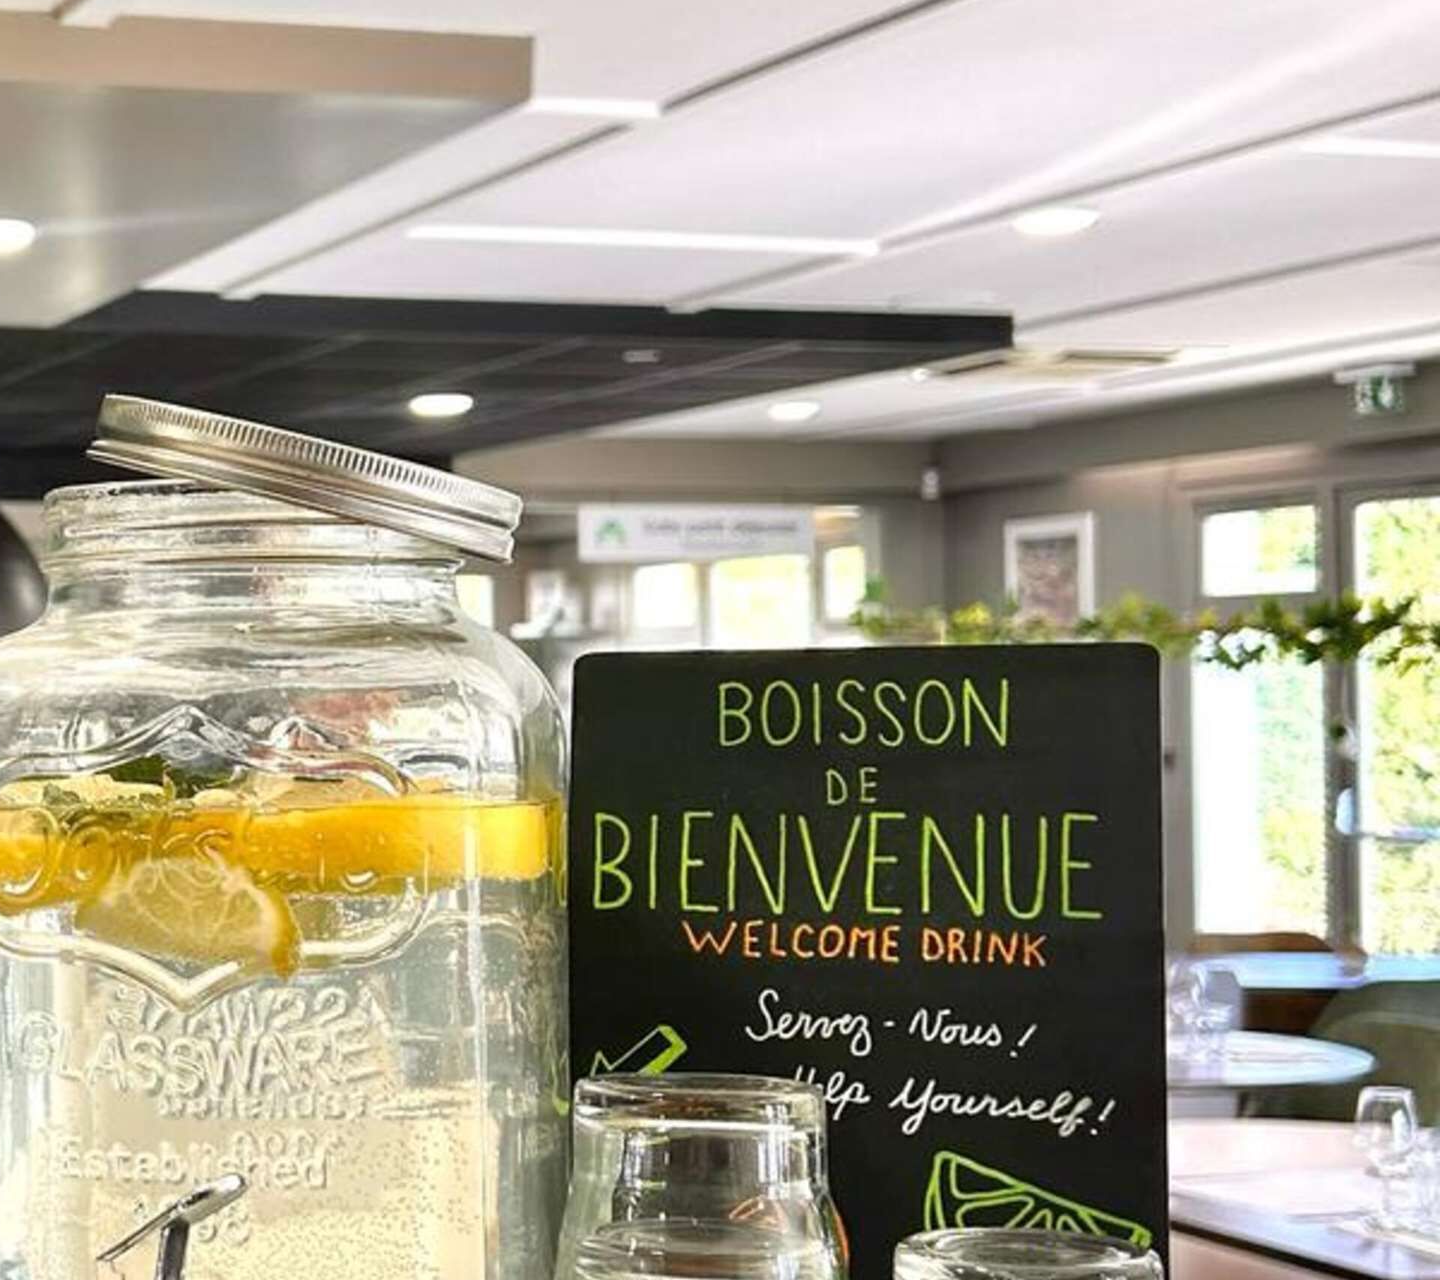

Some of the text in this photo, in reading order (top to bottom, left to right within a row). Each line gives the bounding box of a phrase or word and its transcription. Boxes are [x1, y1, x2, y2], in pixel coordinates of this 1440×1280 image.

[717, 677, 1010, 747] BOISSON
[826, 767, 879, 805] DE
[593, 811, 1103, 920] BIENVENUE
[682, 919, 1049, 968] WELCOME DRINK
